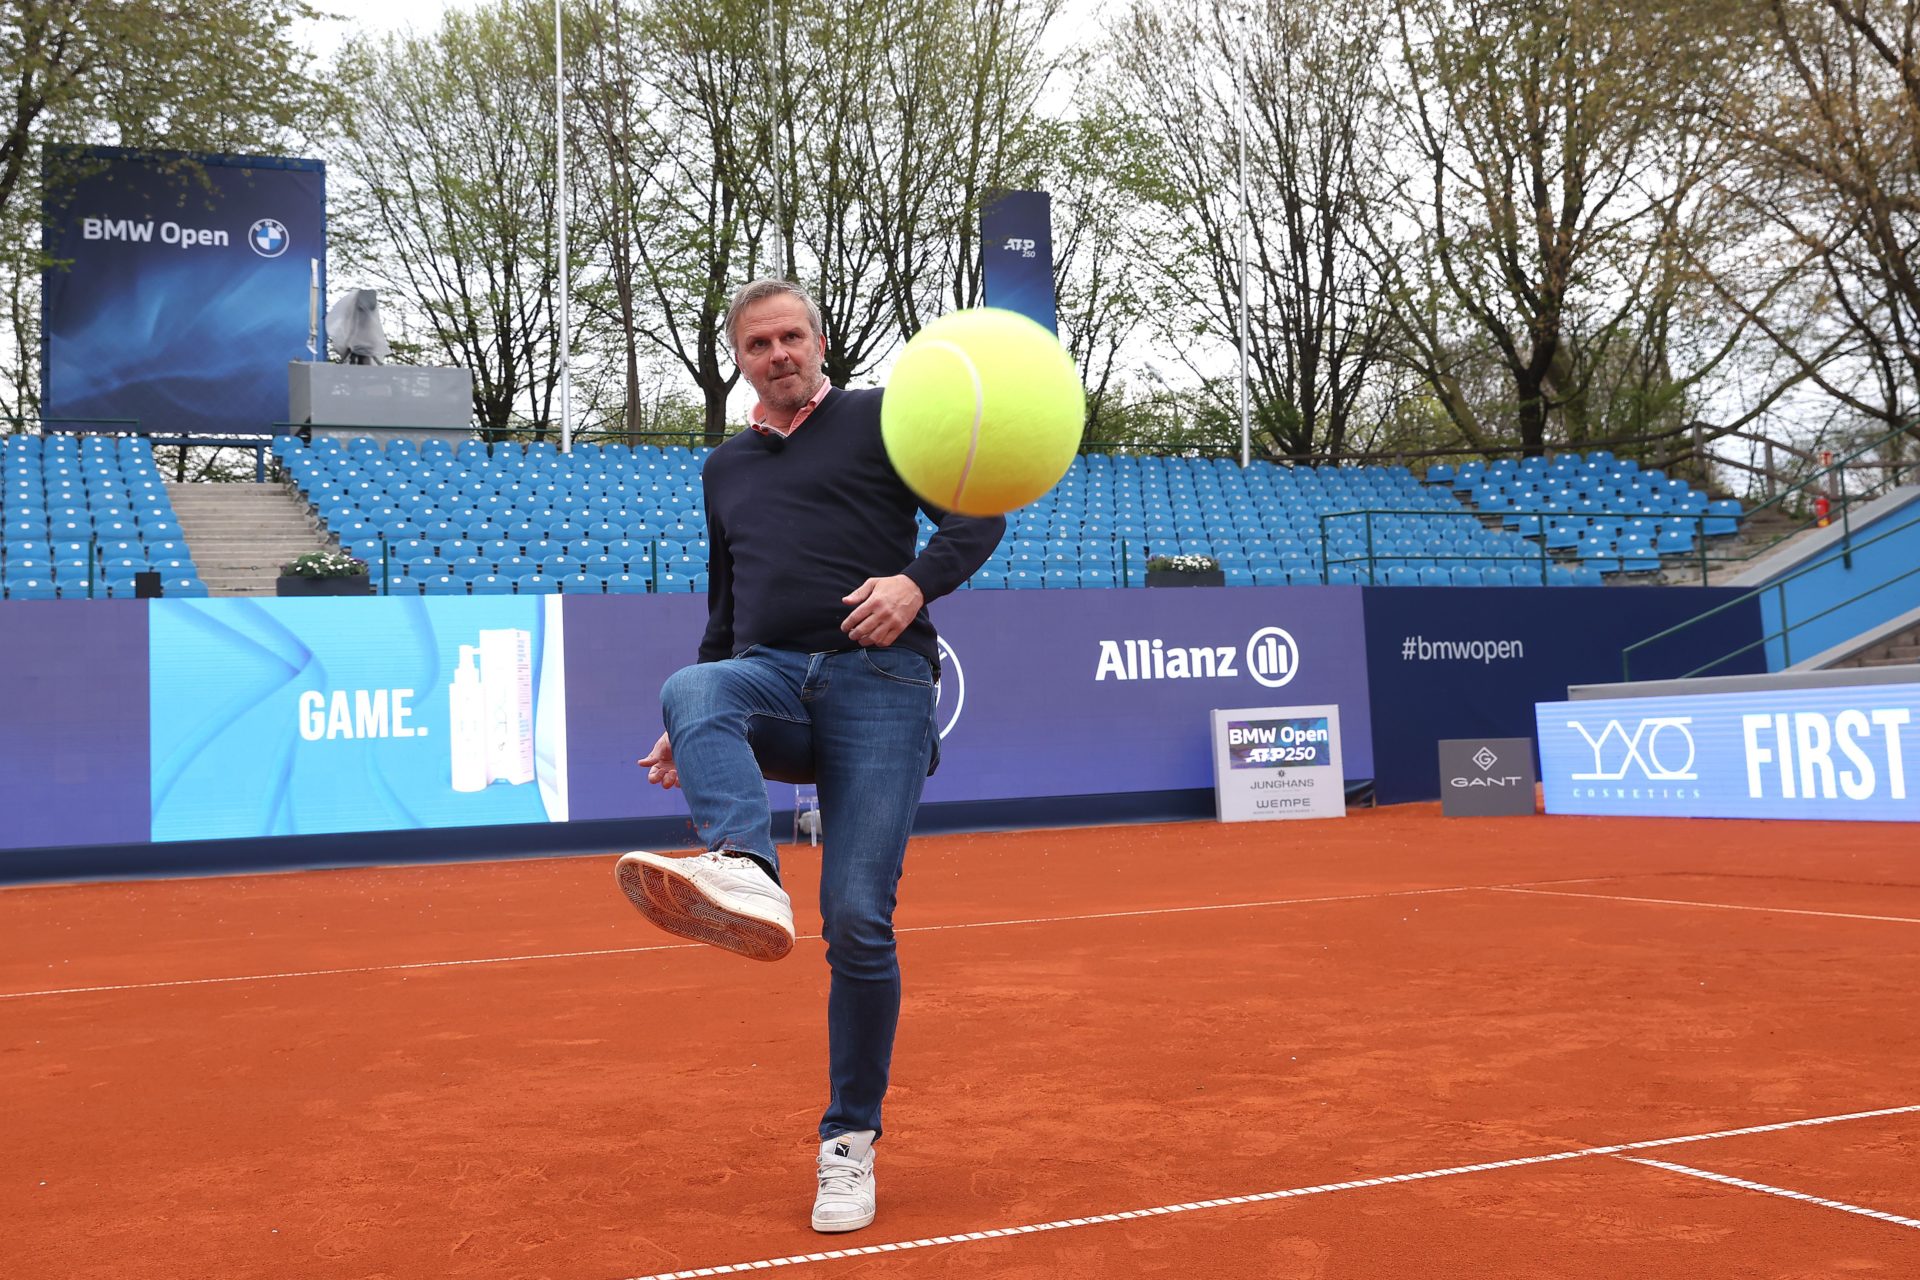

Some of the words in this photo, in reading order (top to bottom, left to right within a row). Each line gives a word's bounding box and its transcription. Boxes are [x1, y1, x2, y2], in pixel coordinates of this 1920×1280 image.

[83, 217, 154, 242] BMW
[160, 221, 229, 249] Open
[1003, 238, 1036, 251] ATP
[1022, 250, 1036, 258] 250
[1402, 635, 1524, 664] #bmwopen
[1095, 639, 1238, 681] Allianz
[299, 688, 429, 741] GAME.
[1229, 727, 1277, 745] BMW
[1280, 726, 1328, 746] Open
[1742, 708, 1911, 801] FIRST
[1250, 778, 1315, 790] JUNGHANS
[1450, 776, 1522, 788] GANT
[1572, 787, 1701, 799] COSMETICS
[1256, 797, 1311, 809] WEMPE
